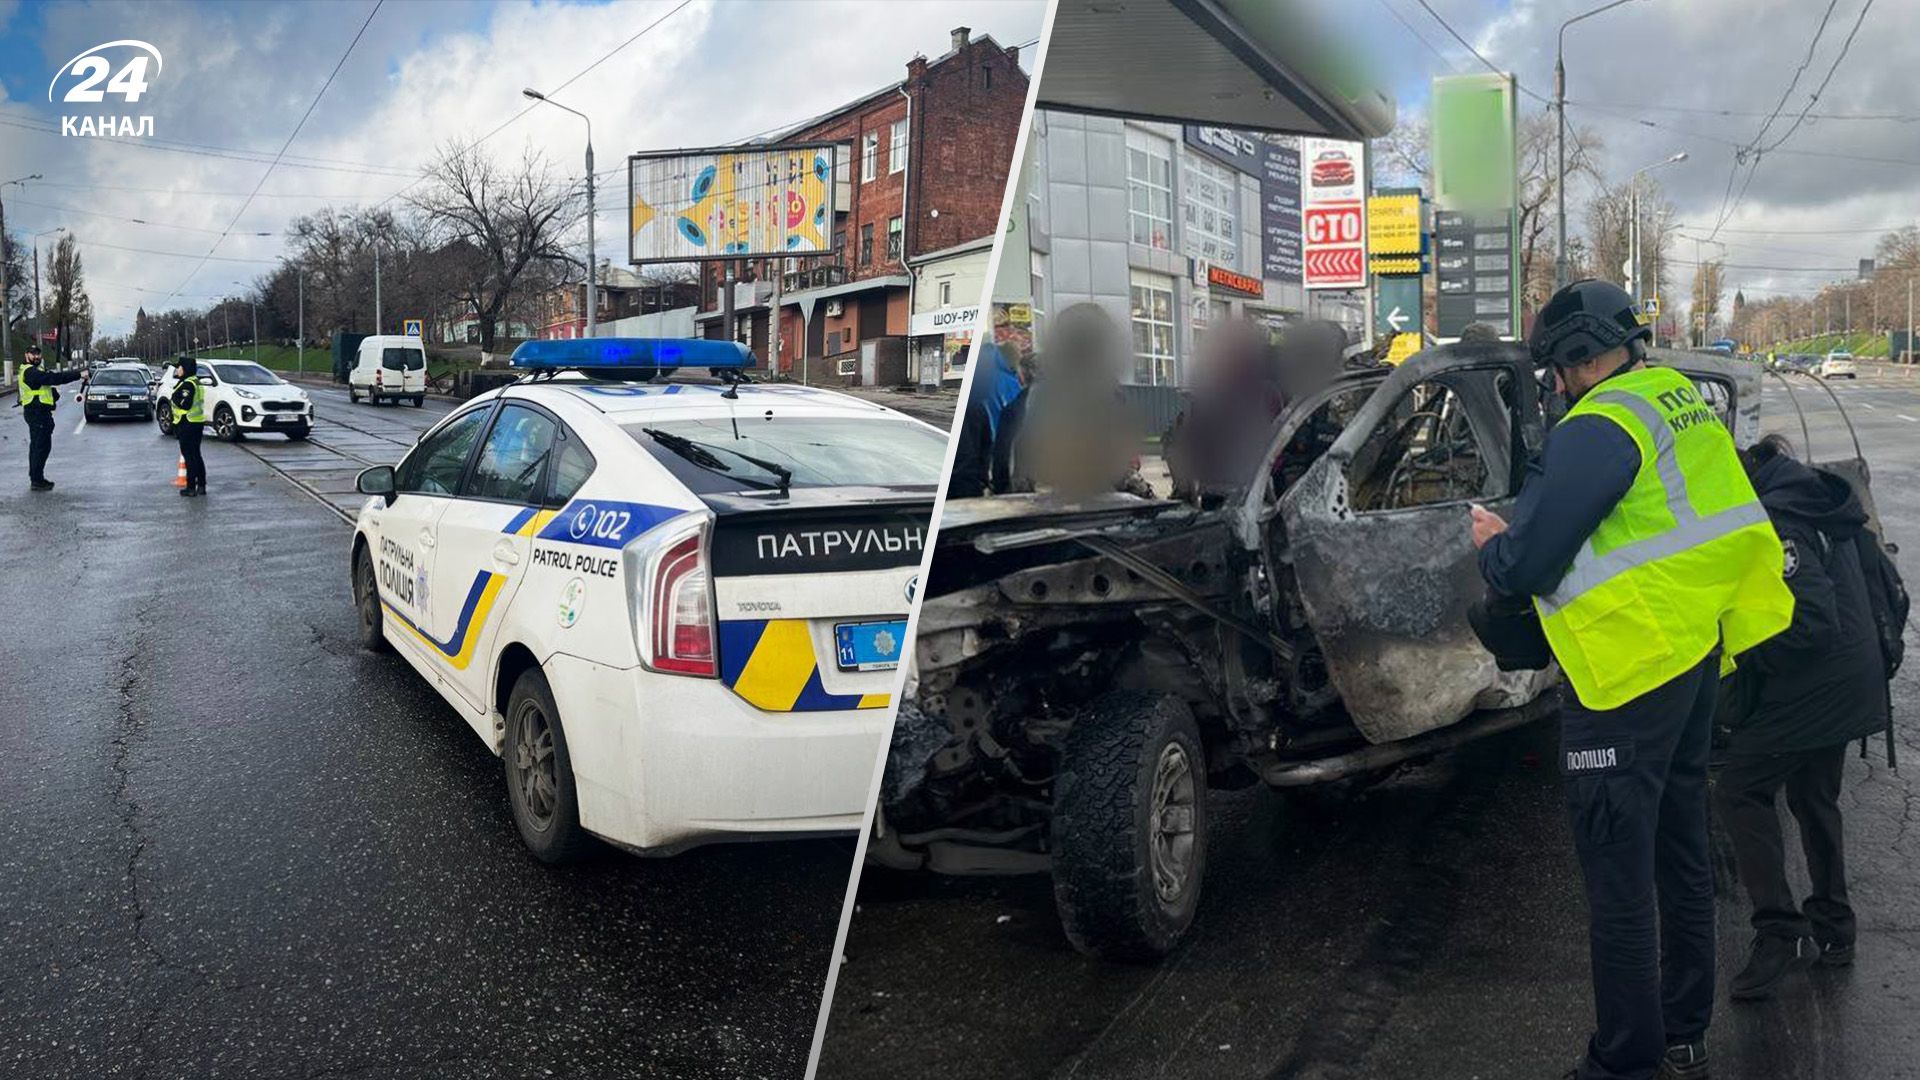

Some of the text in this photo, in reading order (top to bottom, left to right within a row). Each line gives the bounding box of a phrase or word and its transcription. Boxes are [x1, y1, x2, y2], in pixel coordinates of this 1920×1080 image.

[1308, 213, 1360, 242] СТО
[591, 510, 631, 541] 102
[379, 535, 415, 572] ПАТРУЛЬНА
[757, 527, 923, 560] ПАТРУЛЬН
[532, 548, 618, 578] PATROL POLICE
[379, 559, 415, 608] ПОЛІЦІЯ
[841, 647, 854, 660] 11
[1566, 747, 1616, 770] ПОЛІЦІЯ
